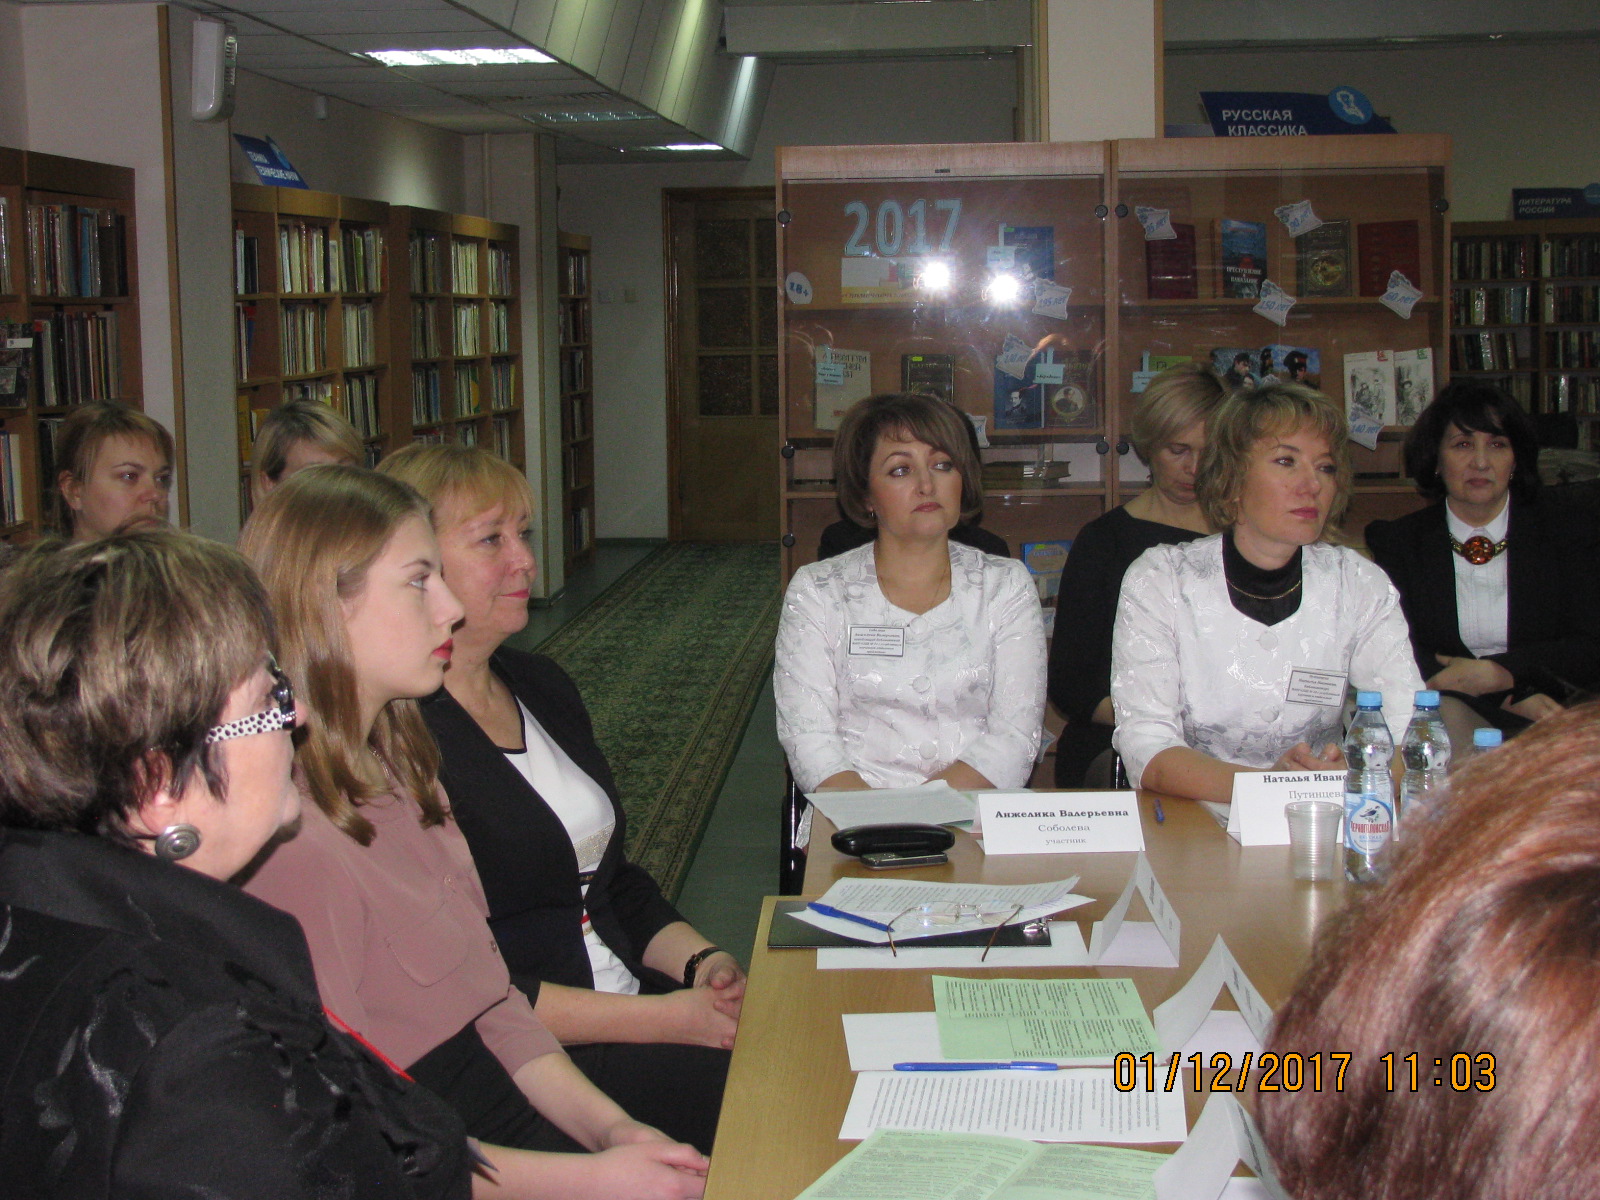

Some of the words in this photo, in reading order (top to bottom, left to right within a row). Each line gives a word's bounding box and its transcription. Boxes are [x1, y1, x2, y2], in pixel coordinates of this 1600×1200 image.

[1221, 109, 1293, 121] РУССКАЯ
[1227, 124, 1309, 137] КЛАССИКА
[1518, 197, 1573, 206] ЛИТЕРАТУРА
[1518, 206, 1556, 214] РОССИИ
[843, 198, 963, 257] 2017
[1262, 774, 1310, 783] Наталья
[1313, 773, 1346, 782] Ивано
[1288, 790, 1345, 801] Путинцева
[995, 810, 1056, 819] Анжелика
[1059, 809, 1129, 819] Валерьевна
[1037, 824, 1091, 832] Соболева
[1045, 837, 1087, 846] участник
